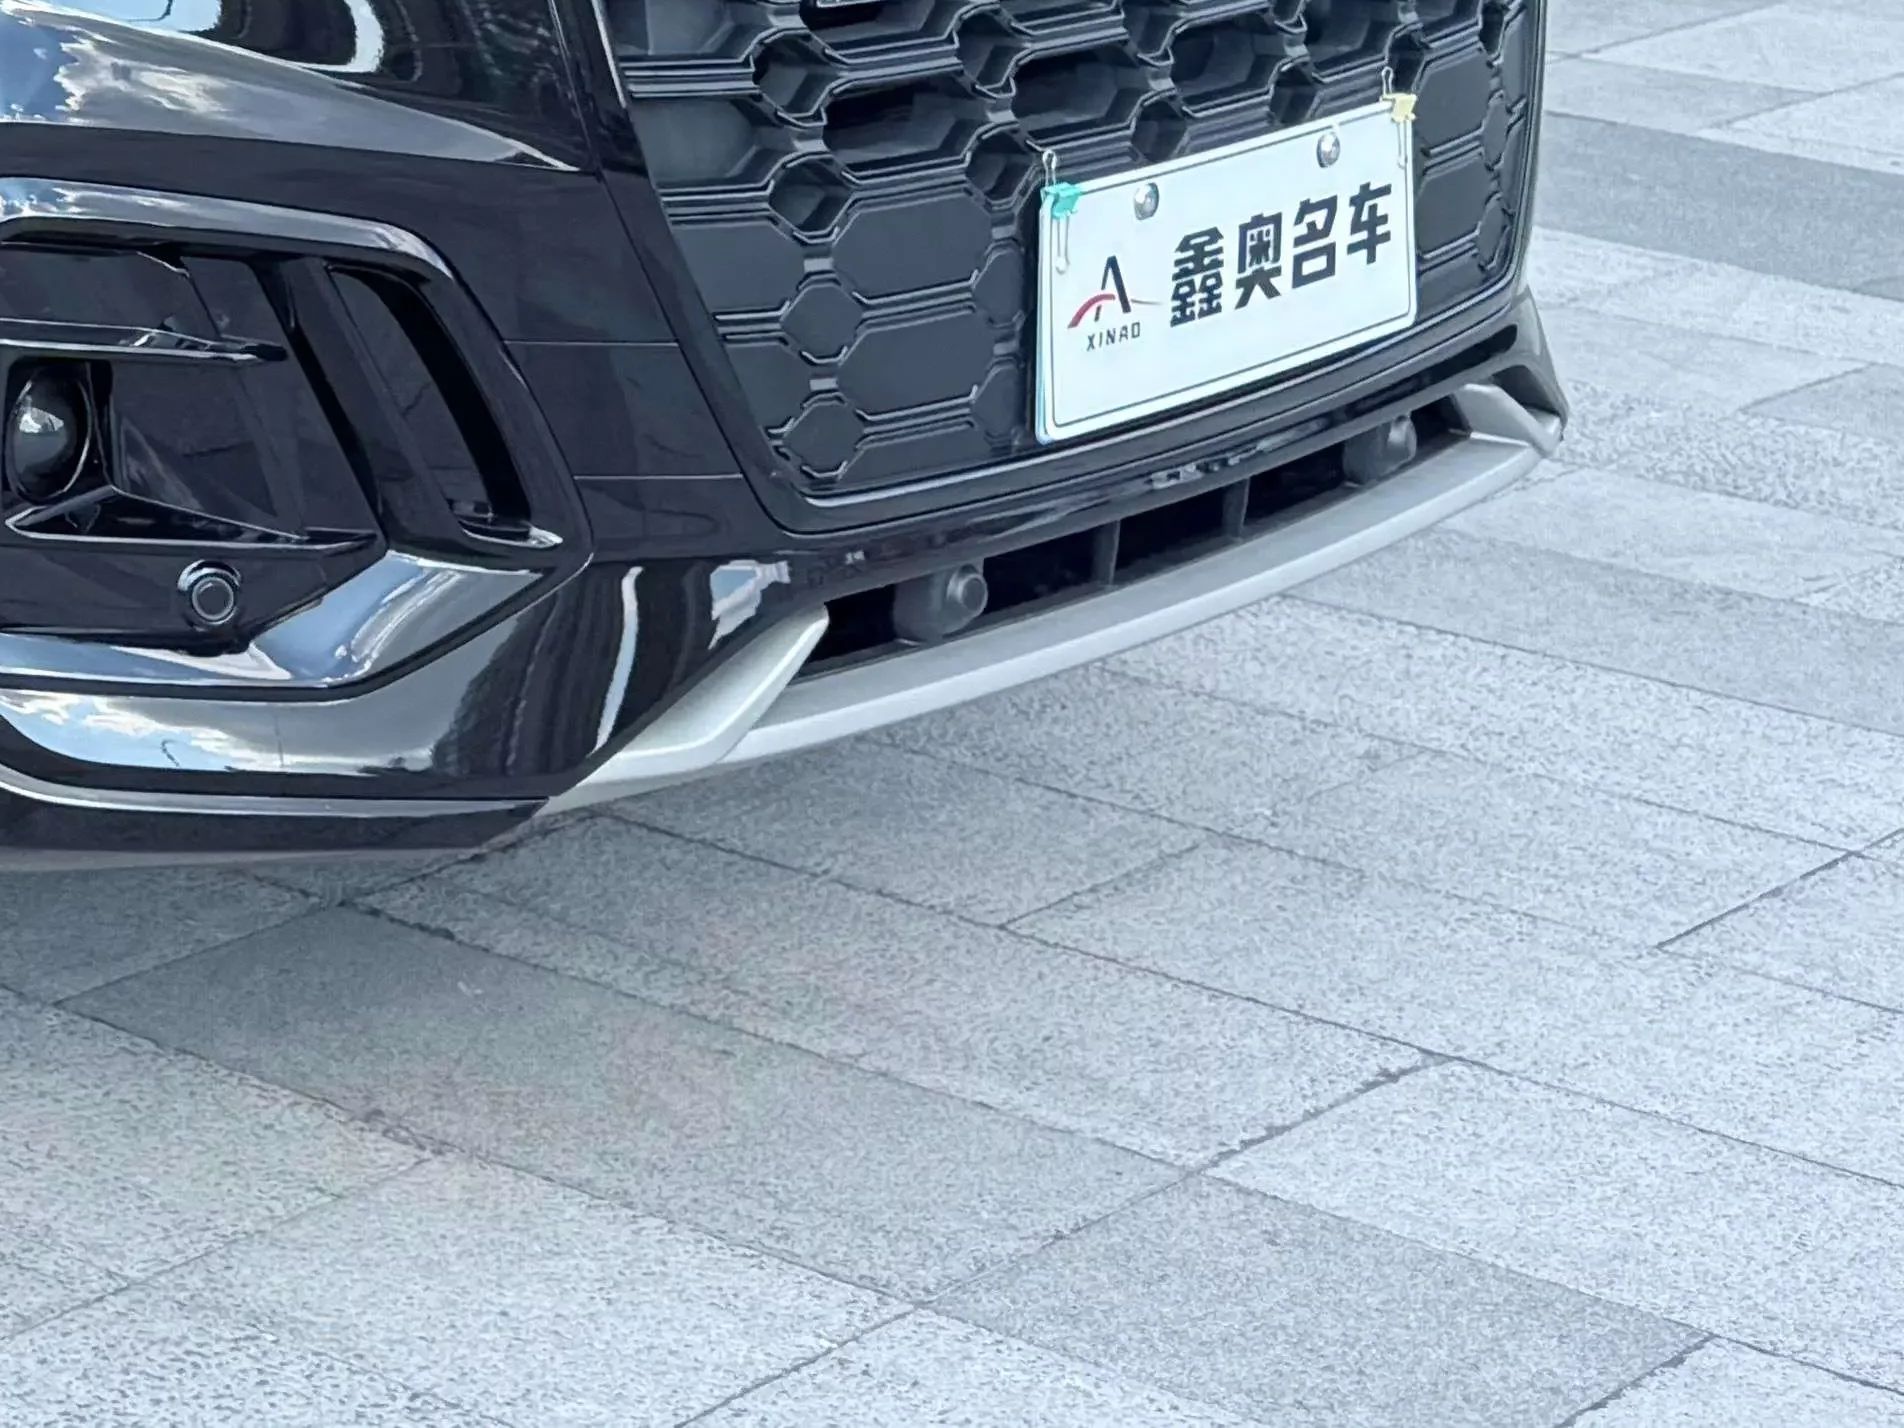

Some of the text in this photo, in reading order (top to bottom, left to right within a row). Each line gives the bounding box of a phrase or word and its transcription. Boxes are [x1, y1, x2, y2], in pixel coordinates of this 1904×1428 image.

[1169, 181, 1393, 328] 鑫奥名车
[1086, 321, 1142, 353] XINAO
